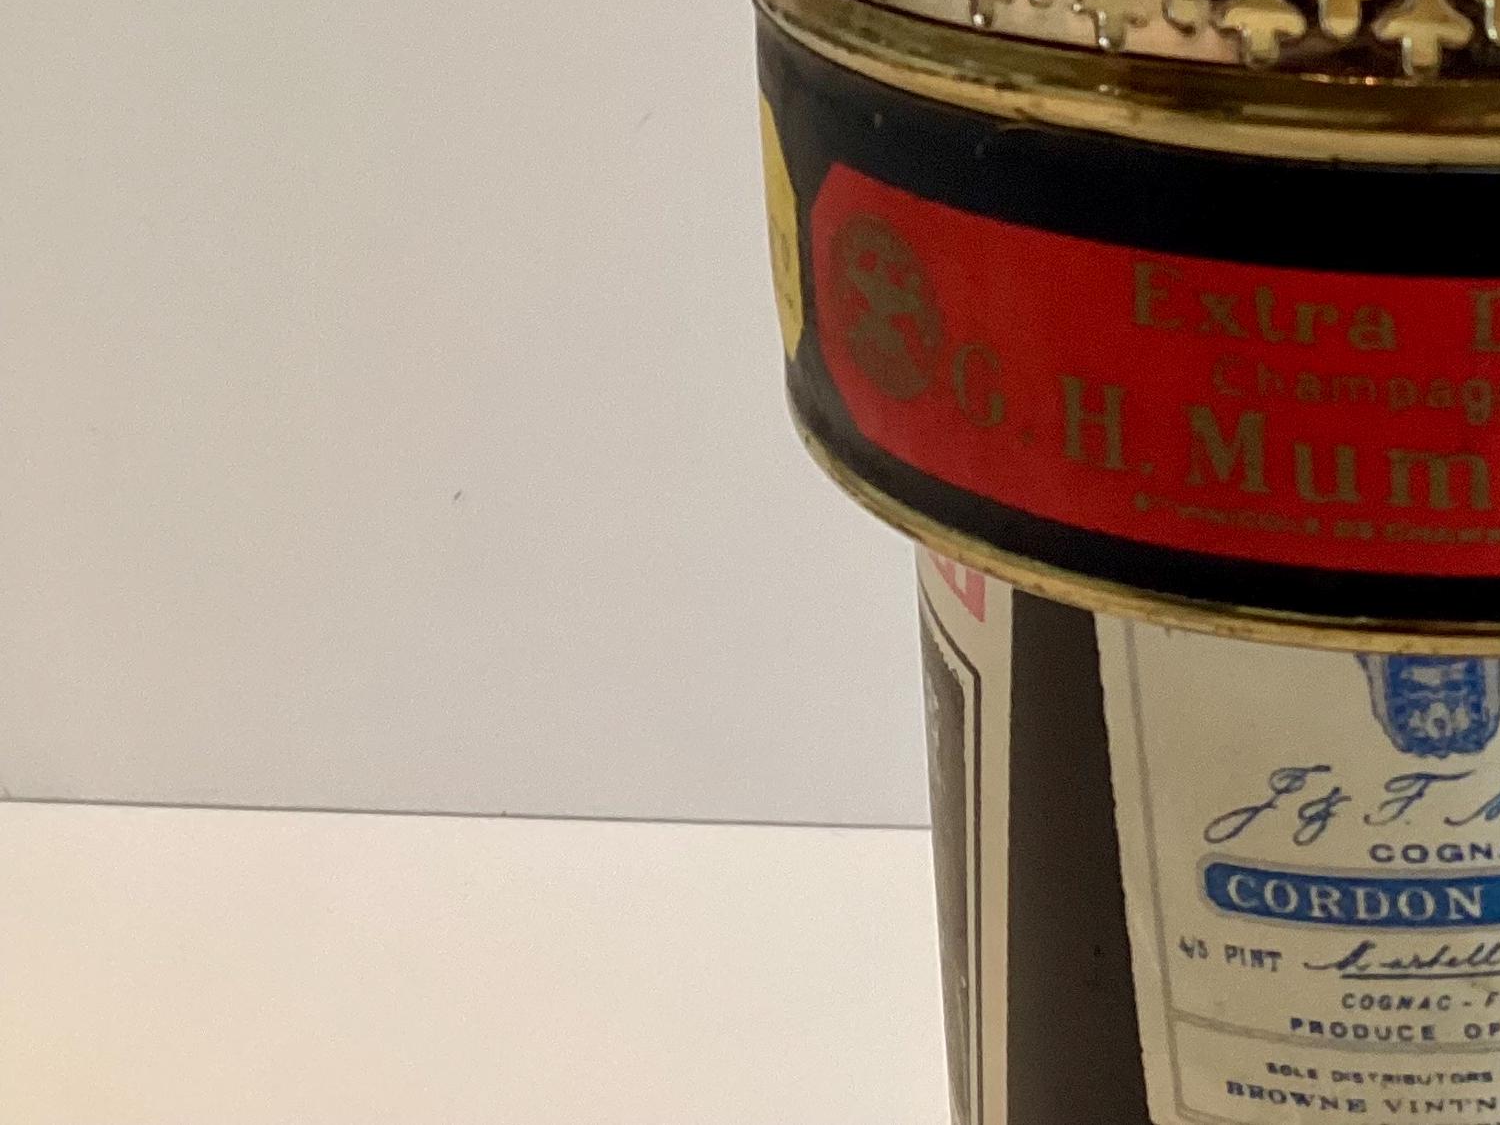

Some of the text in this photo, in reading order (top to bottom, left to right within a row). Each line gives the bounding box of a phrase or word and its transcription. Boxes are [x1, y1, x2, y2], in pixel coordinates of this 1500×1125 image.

[1132, 261, 1398, 351] Extra
[1225, 873, 1485, 920] CORDON
[1224, 943, 1282, 972] PINT
[1341, 992, 1452, 1012] COGNAC
[1290, 1016, 1436, 1043] PRODUCE
[1266, 1061, 1319, 1081] SOLE
[1331, 1069, 1493, 1087] DISTRIBUTORS
[1226, 1079, 1368, 1114] BROWNE
